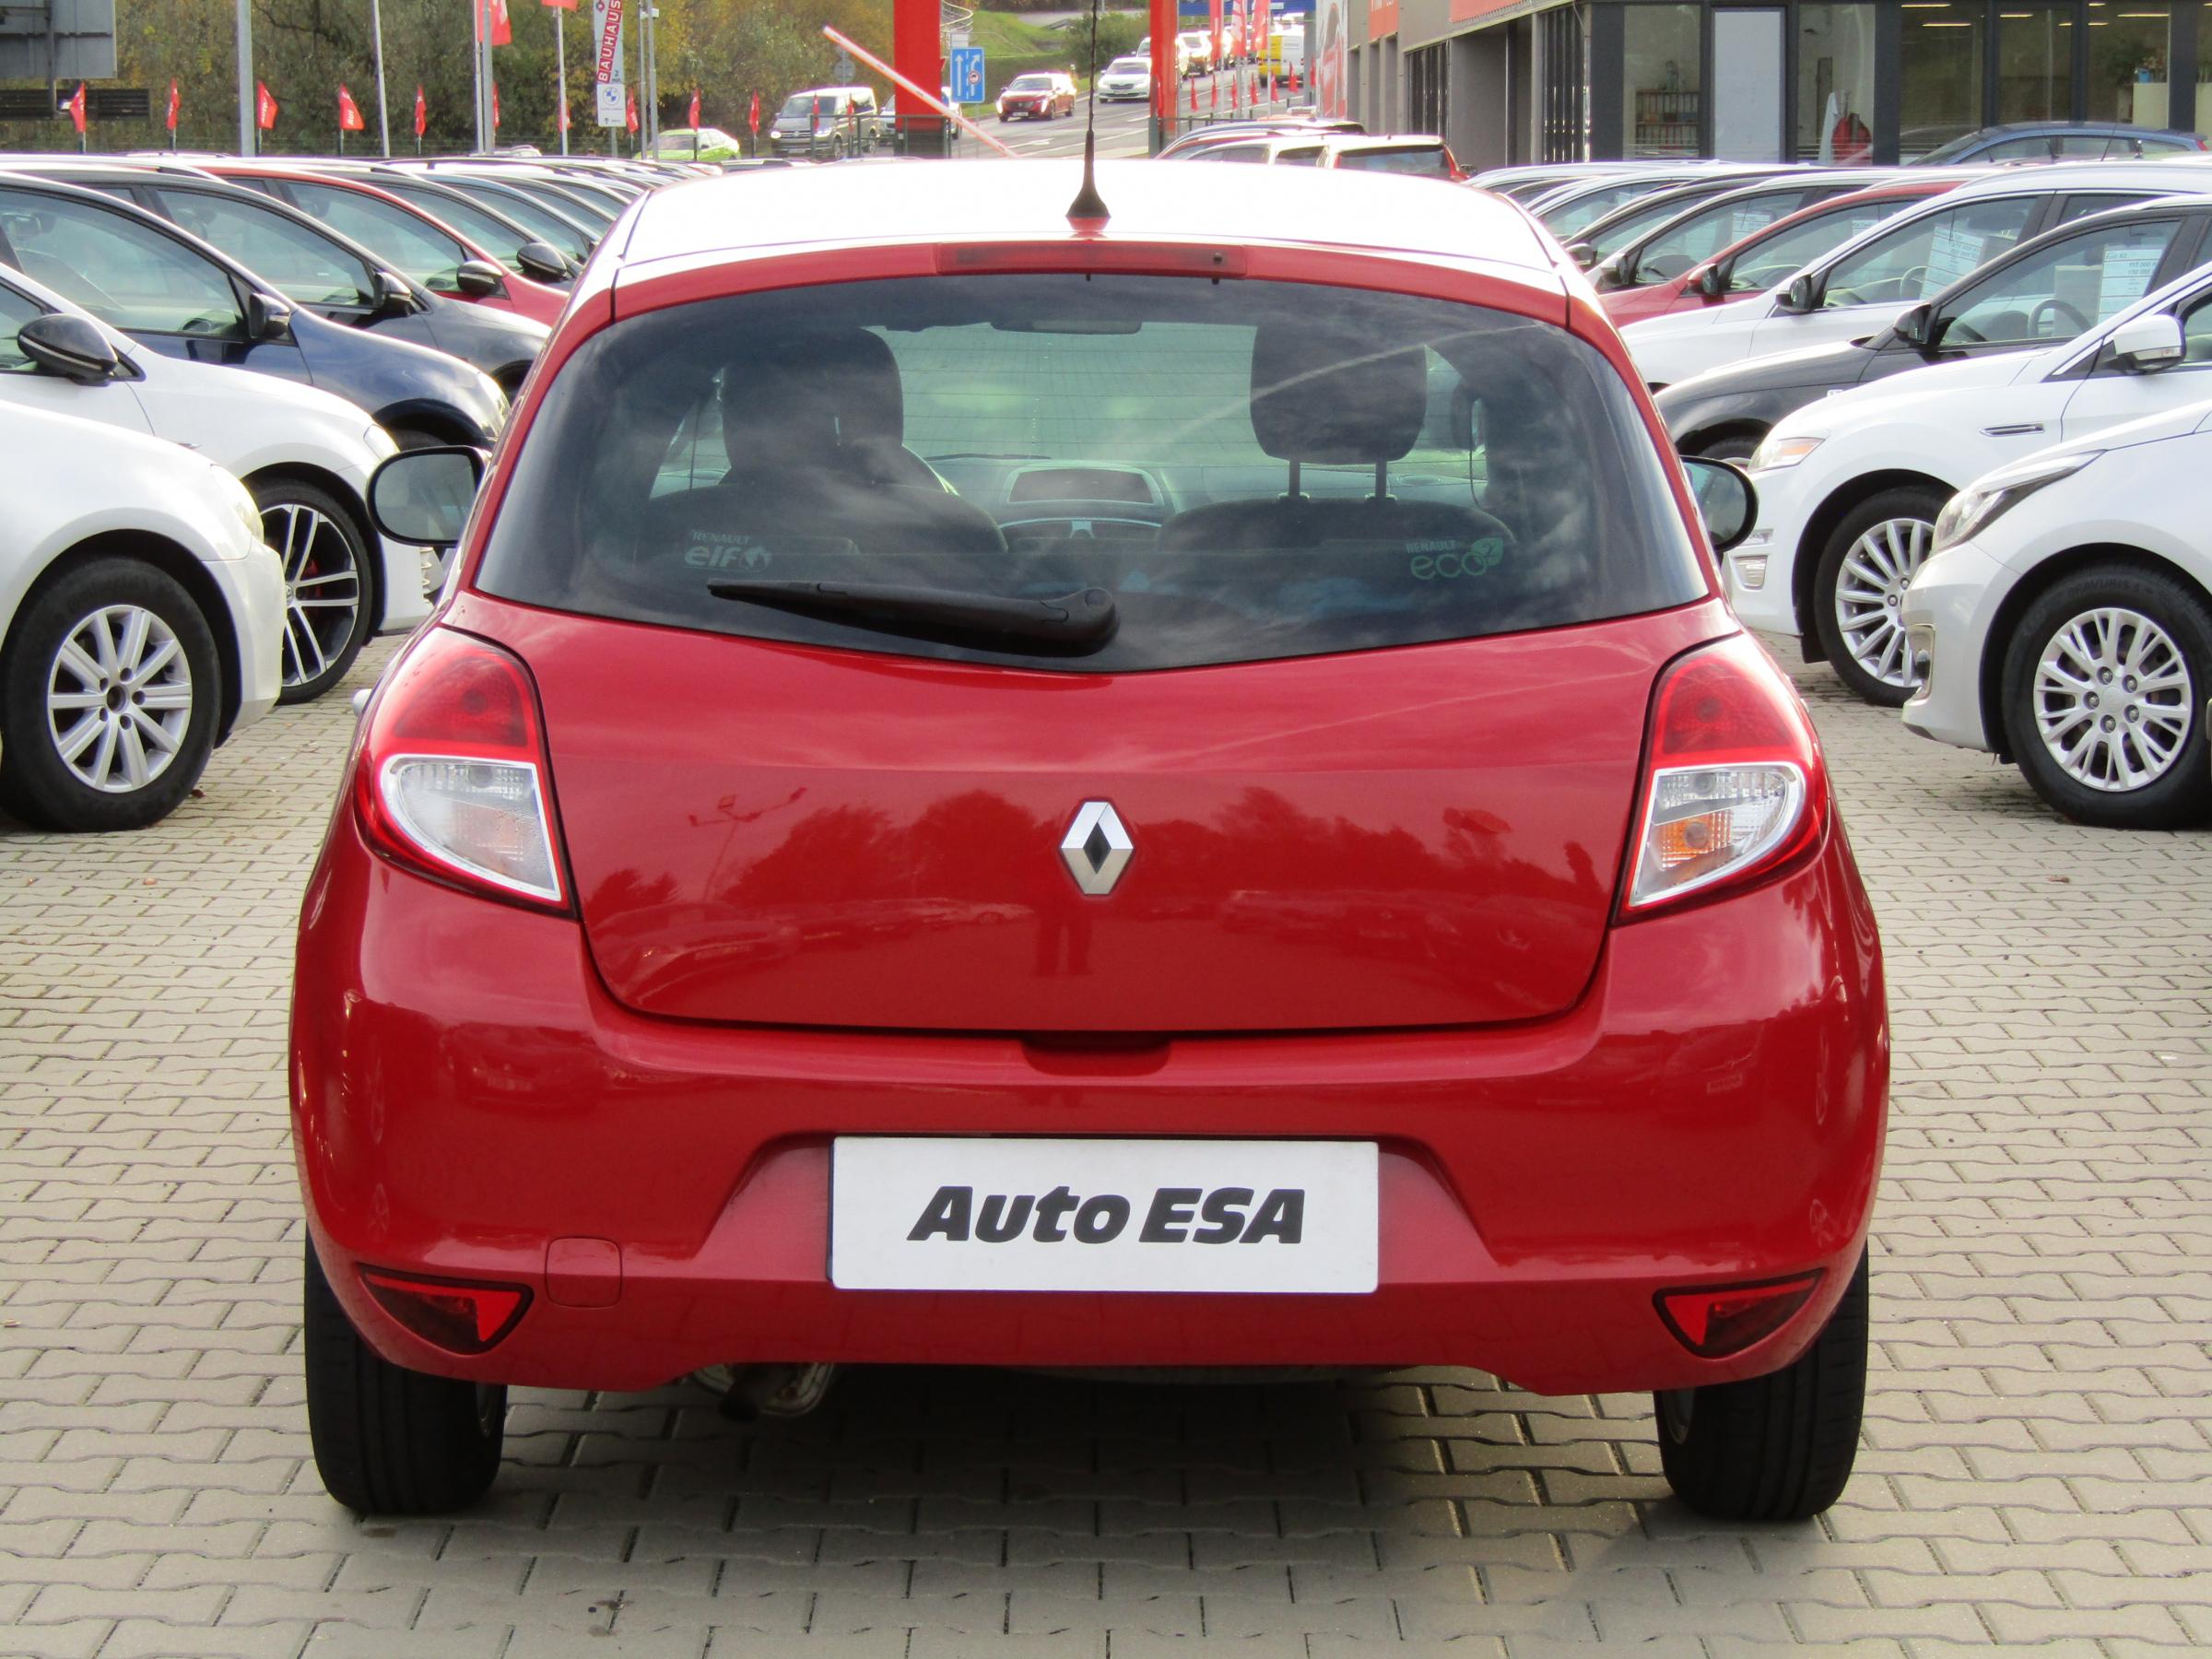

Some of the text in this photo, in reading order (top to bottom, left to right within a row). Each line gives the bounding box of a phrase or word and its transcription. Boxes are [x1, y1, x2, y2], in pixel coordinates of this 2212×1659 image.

[597, 0, 621, 82] BAUHAUS
[684, 545, 741, 568] elf
[1406, 539, 1456, 553] RENAULT
[907, 1186, 1305, 1243] Auto ESA
